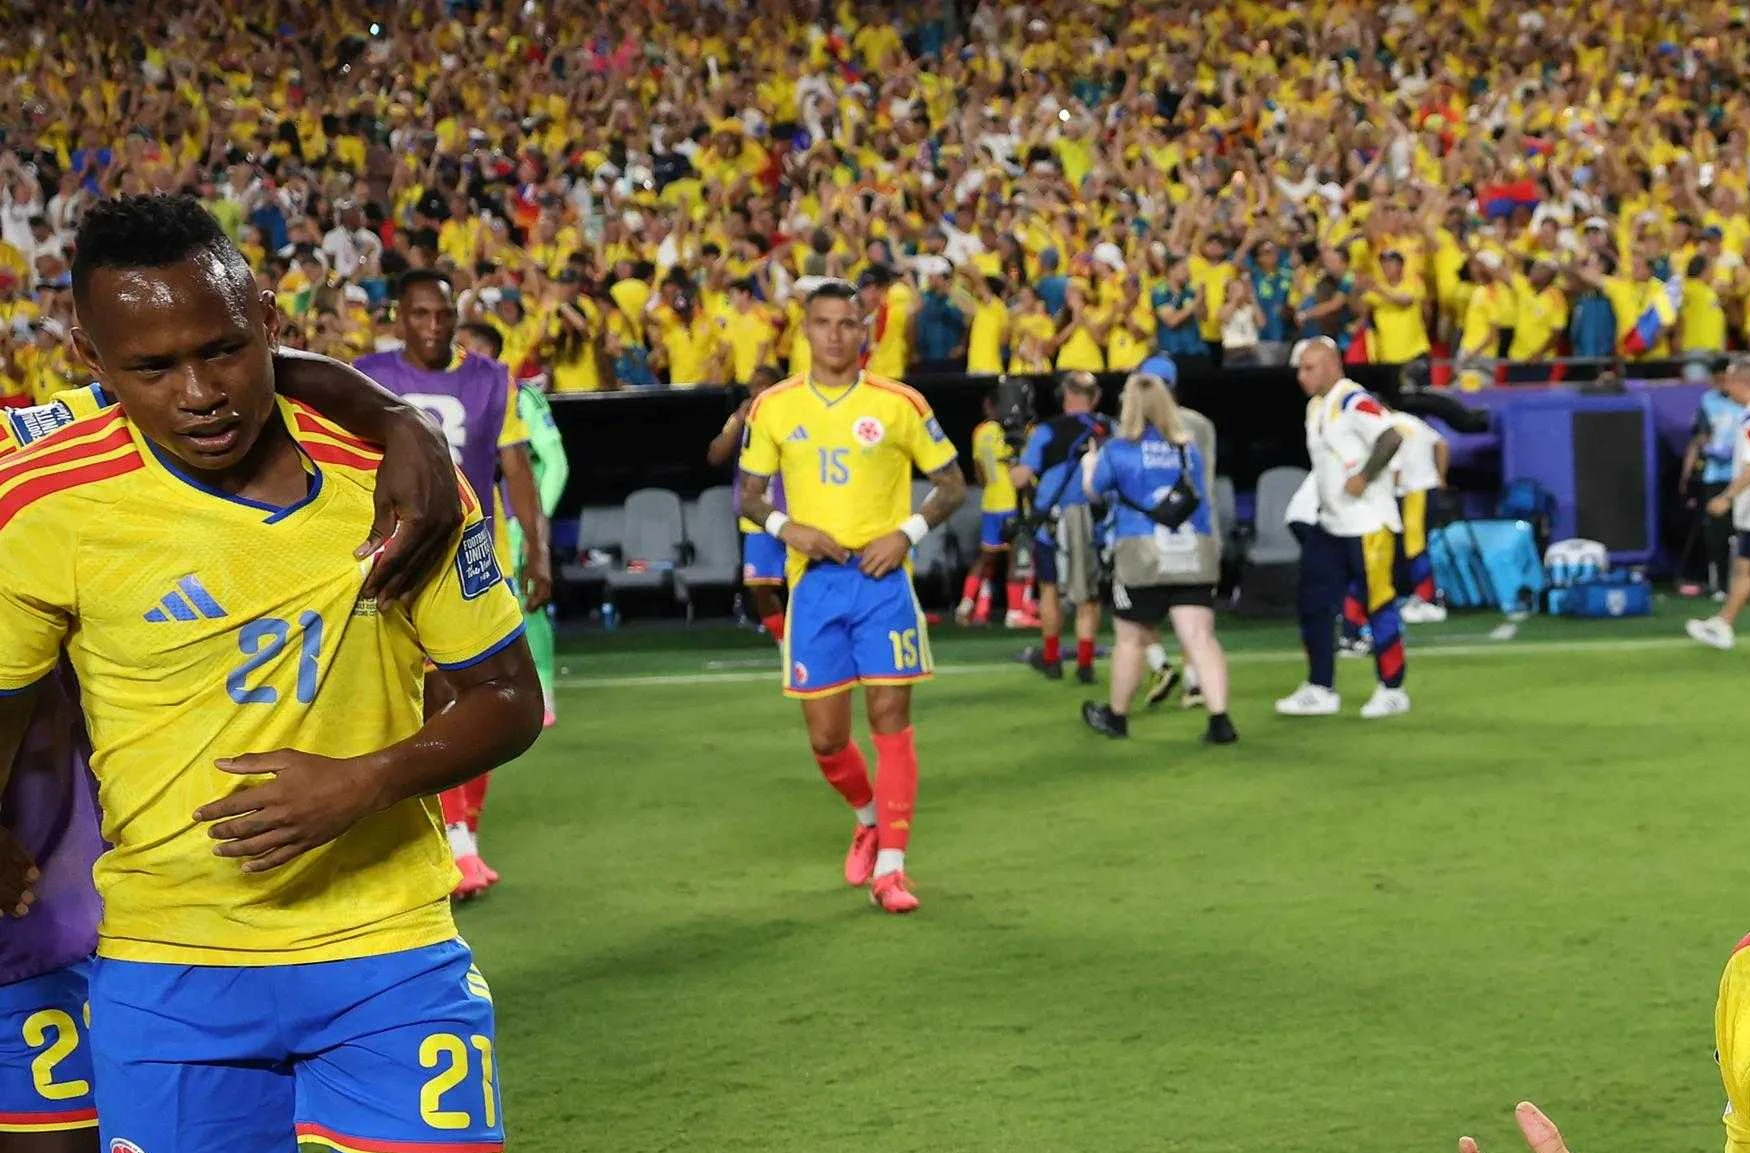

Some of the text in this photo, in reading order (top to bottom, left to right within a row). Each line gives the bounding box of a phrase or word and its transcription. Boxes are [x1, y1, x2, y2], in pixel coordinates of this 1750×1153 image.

[818, 448, 850, 485] 15
[226, 609, 323, 704] 21
[888, 628, 918, 671] 15
[22, 1000, 91, 1100] 2
[419, 1033, 495, 1129] 21
